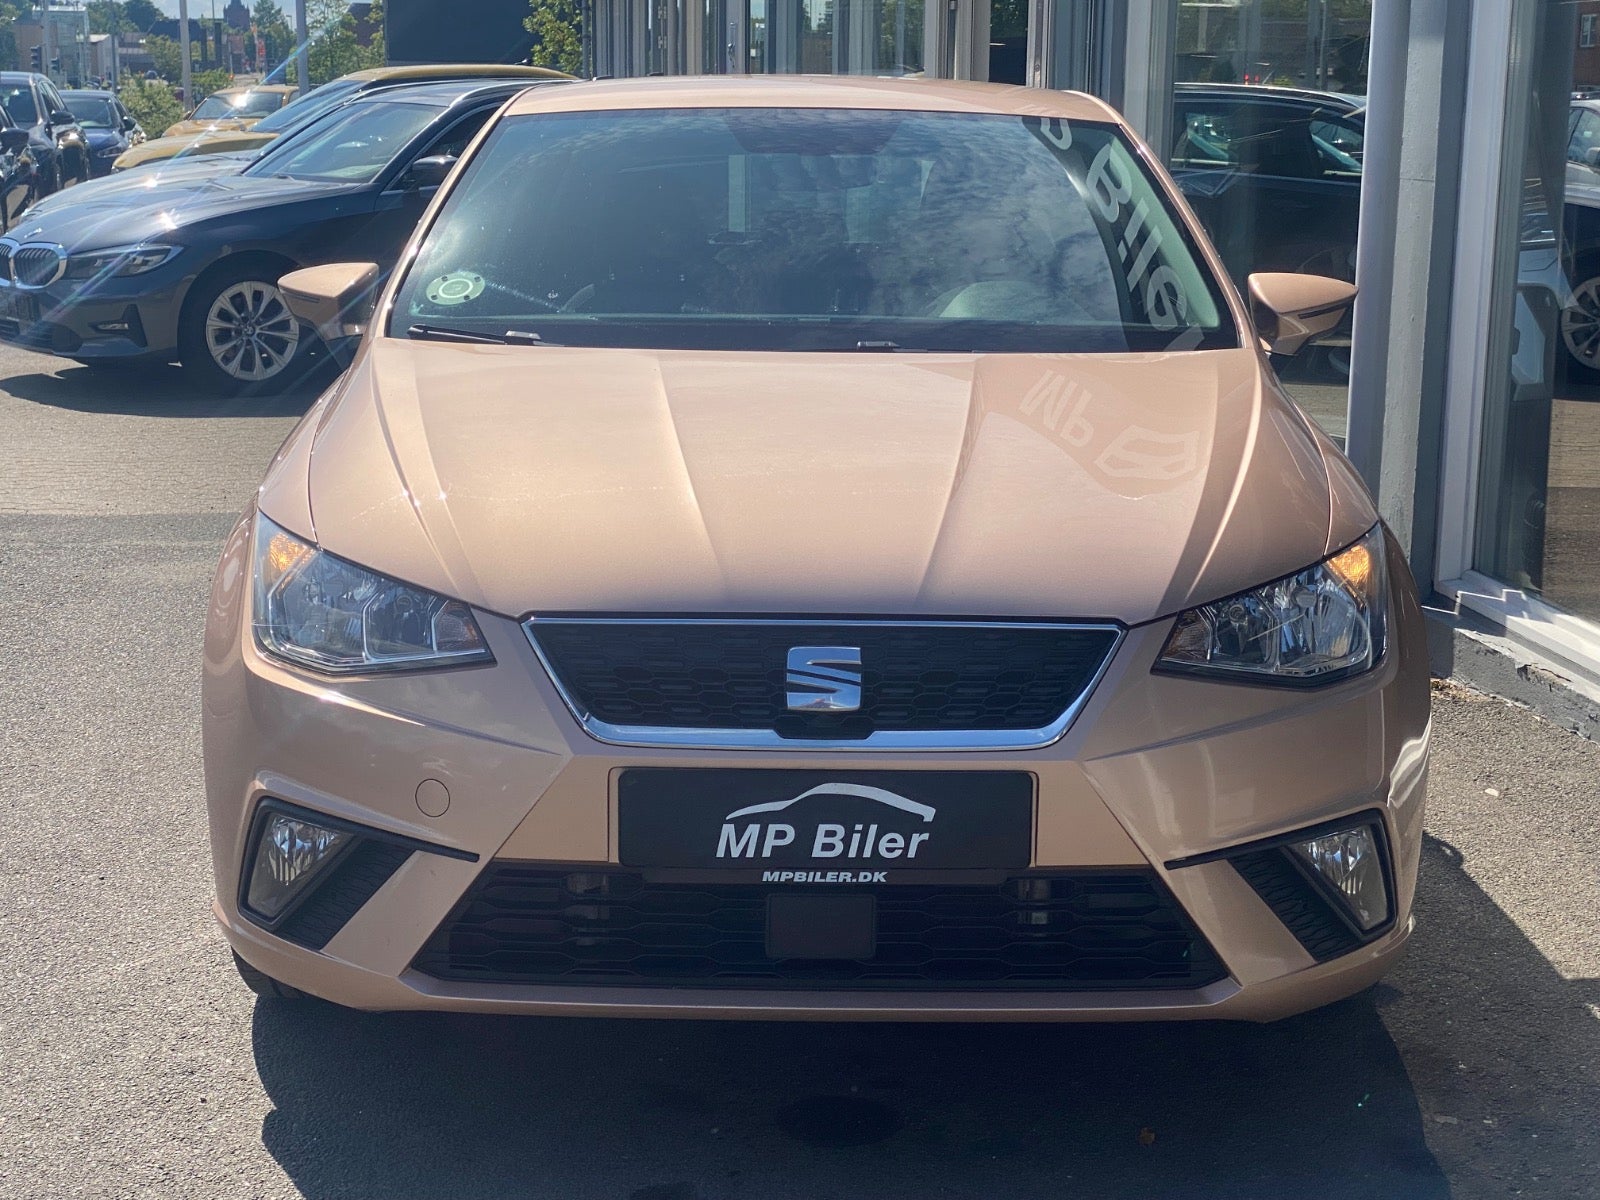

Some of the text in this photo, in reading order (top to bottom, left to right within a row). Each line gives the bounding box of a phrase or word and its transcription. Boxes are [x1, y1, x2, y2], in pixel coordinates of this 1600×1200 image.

[715, 823, 930, 859] MP Biler
[761, 870, 888, 883] MPBILER.DK
